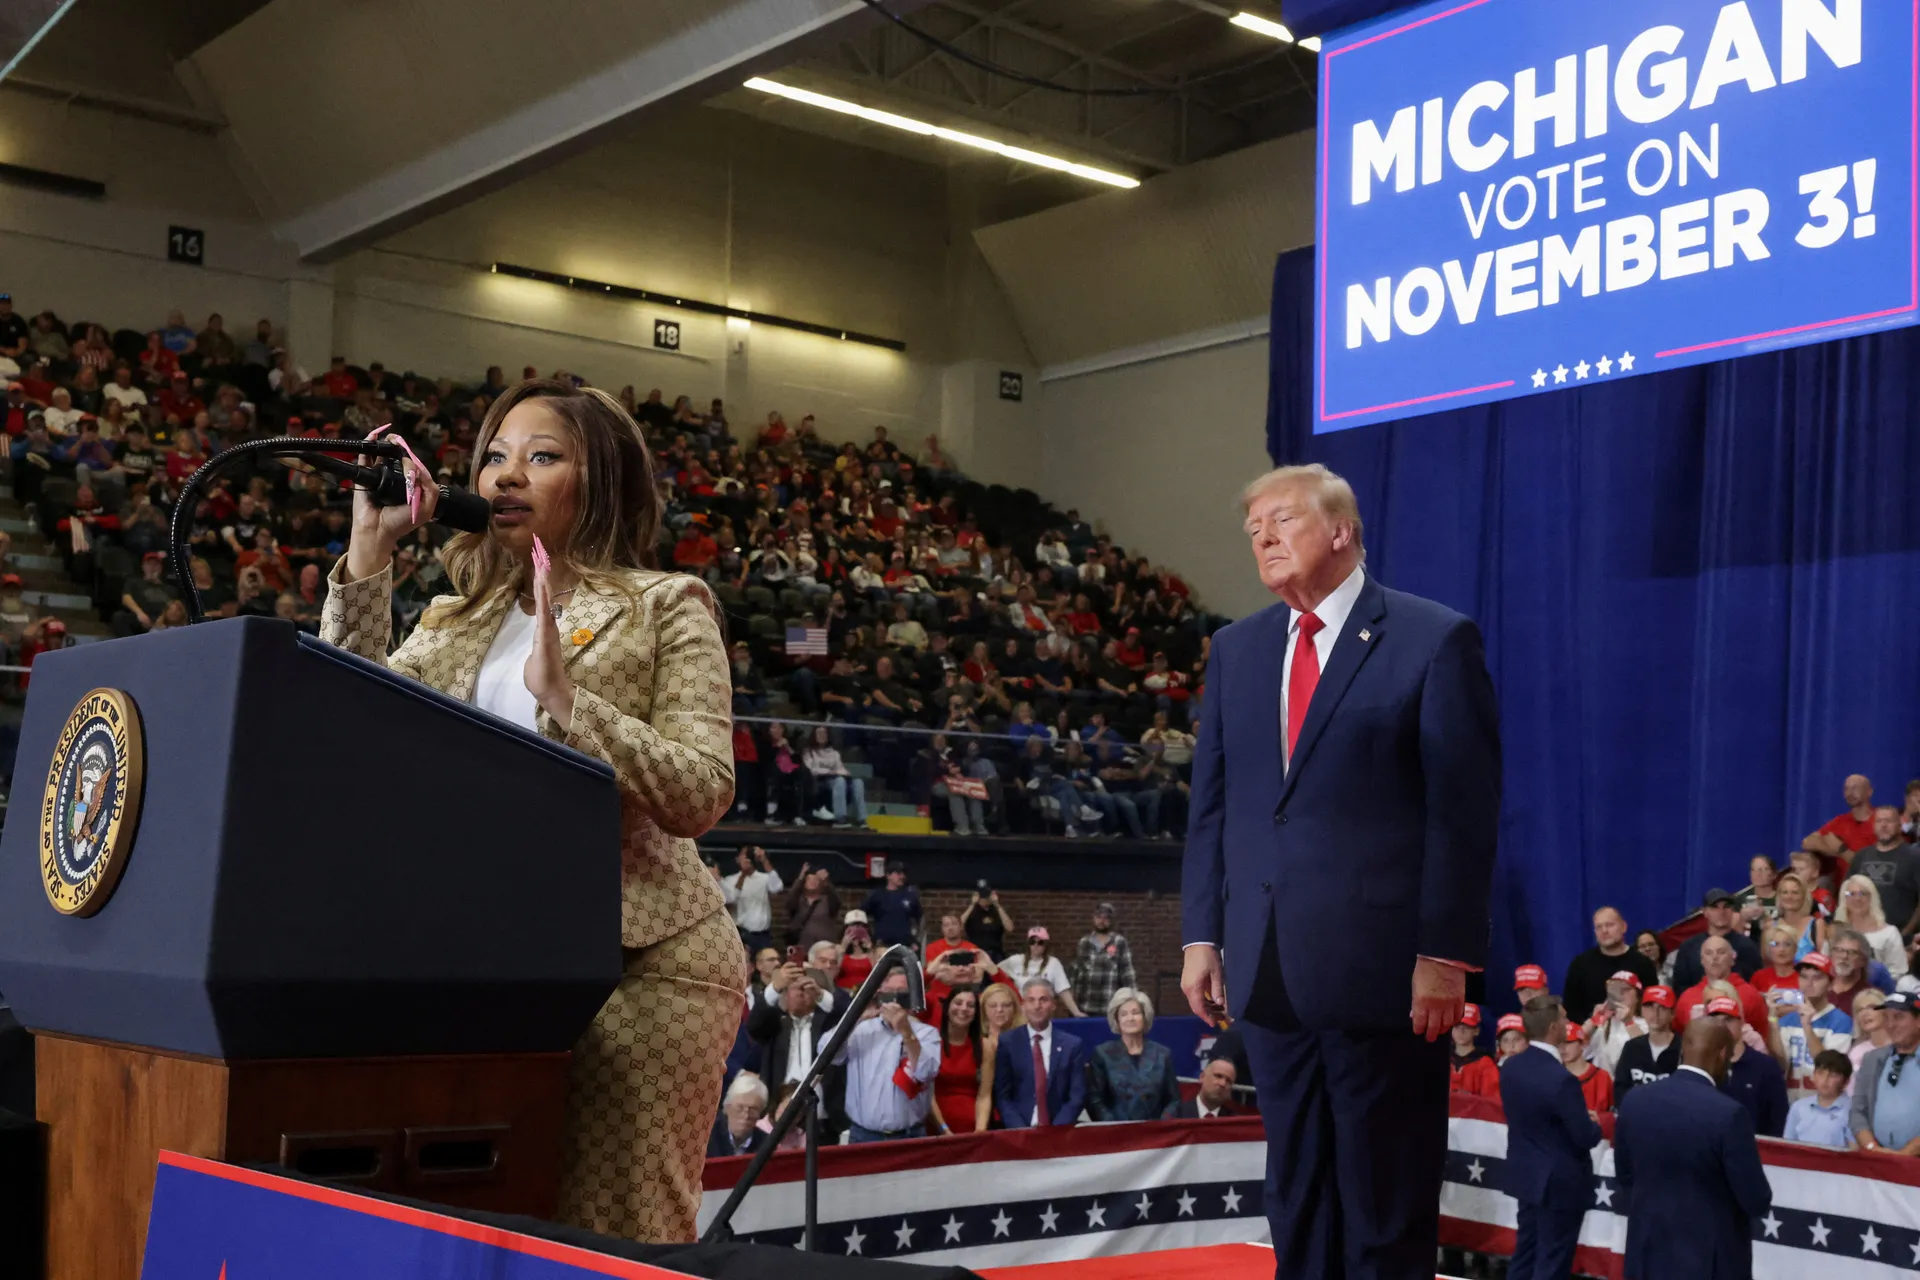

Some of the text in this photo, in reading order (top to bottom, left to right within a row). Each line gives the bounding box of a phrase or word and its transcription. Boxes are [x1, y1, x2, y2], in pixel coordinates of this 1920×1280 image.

[1351, 0, 1863, 206] MICHIGAN
[1459, 122, 1719, 239] VOTE ON
[171, 233, 200, 257] 16
[1345, 157, 1877, 349] NOVEMBER 3!
[656, 324, 678, 345] 18
[1002, 376, 1020, 395] 20
[44, 695, 128, 905] SEAL OF THE PRESIDENT OF THE UNITED STATES
